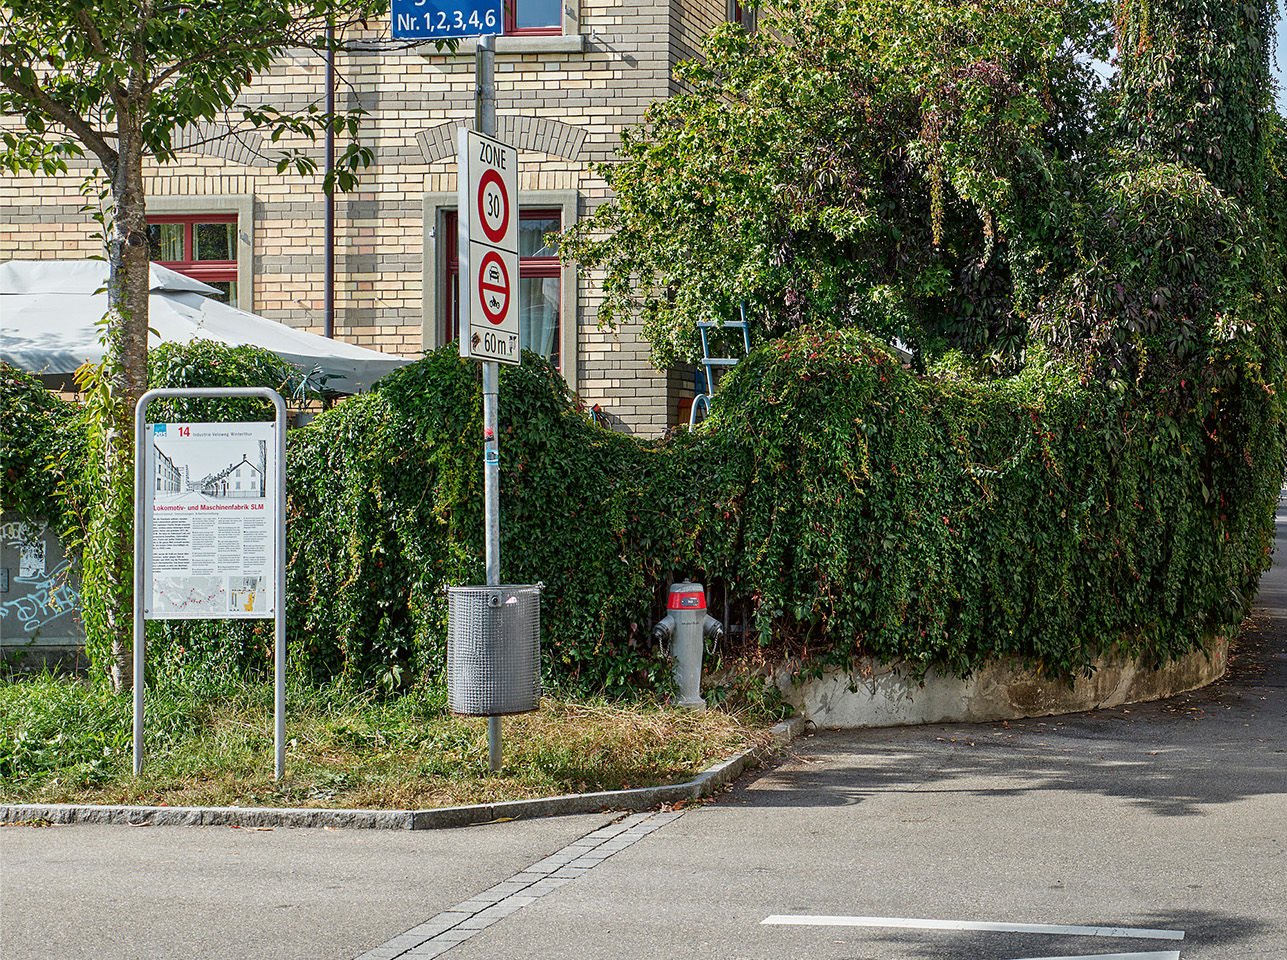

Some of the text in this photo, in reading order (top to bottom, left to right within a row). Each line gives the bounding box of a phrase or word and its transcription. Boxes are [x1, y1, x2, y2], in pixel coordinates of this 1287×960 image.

[397, 13, 420, 32] Nr.
[479, 141, 507, 170] ZONE
[487, 192, 500, 219] 30
[178, 426, 191, 437] 14
[200, 503, 249, 511] Maschinenfabrik
